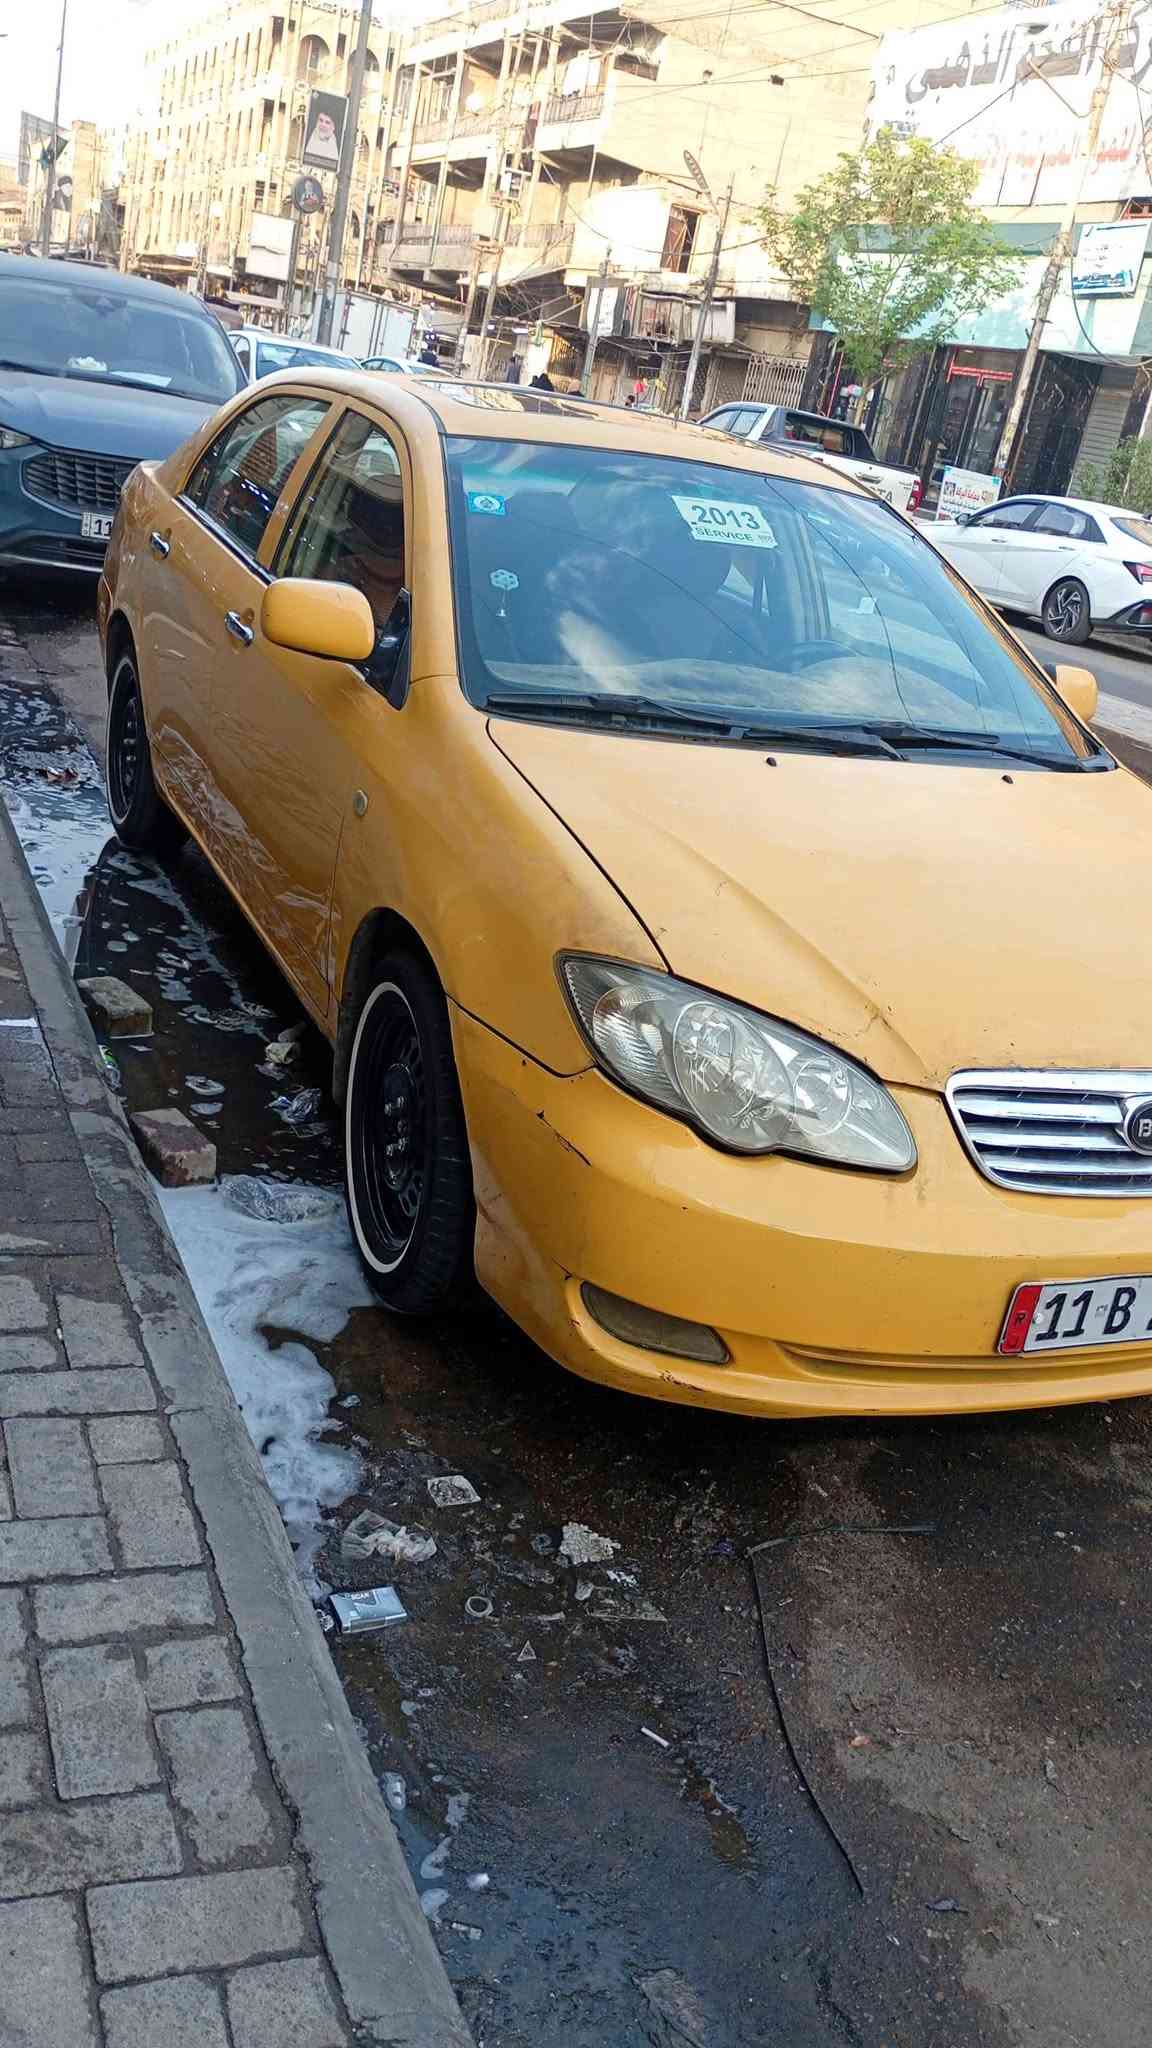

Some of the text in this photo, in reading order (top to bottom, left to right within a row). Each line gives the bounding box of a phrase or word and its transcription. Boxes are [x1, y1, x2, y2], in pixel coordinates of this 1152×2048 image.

[691, 505, 761, 541] 2013 SERVICE
[1035, 1286, 1137, 1342] 11 B
